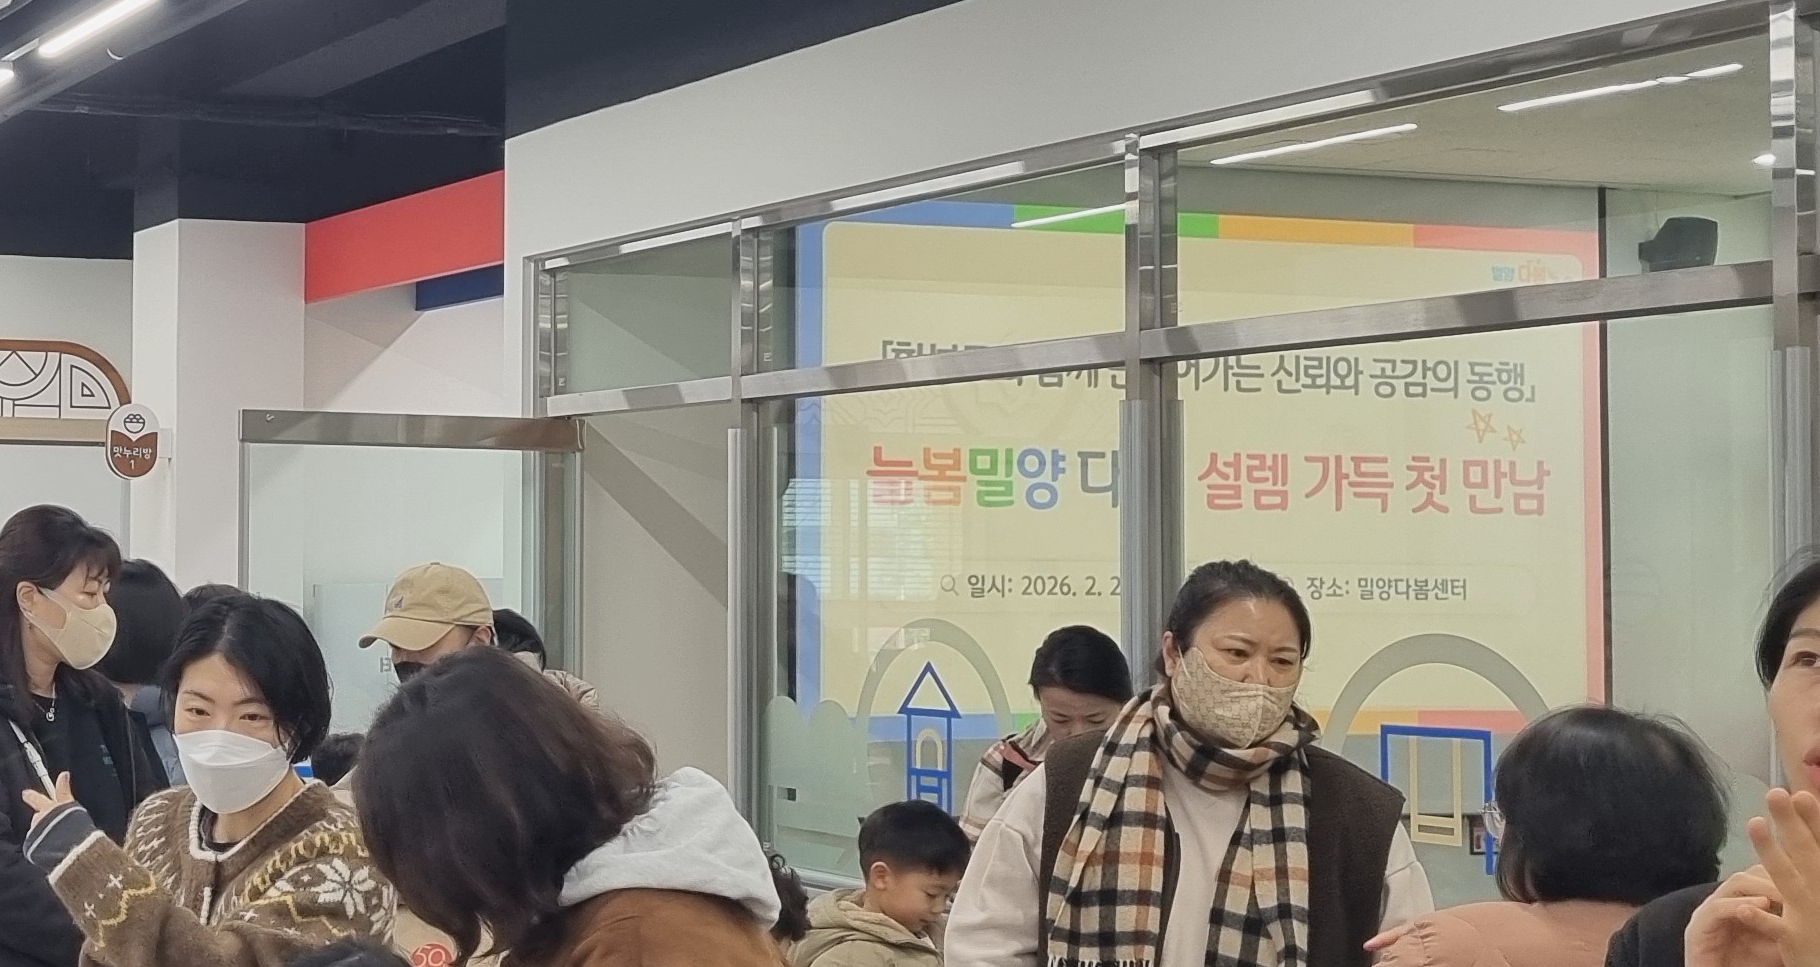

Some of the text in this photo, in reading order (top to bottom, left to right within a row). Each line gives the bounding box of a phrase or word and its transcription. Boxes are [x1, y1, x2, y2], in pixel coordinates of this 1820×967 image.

[1270, 354, 1364, 396] 신뢰와
[1369, 357, 1460, 399] 공감의
[113, 446, 152, 460] 맛누리방
[129, 459, 135, 470] 1
[866, 445, 1120, 510] 늘봄밀양 다
[1197, 452, 1552, 516] 설렘 가득 첫 만남
[967, 574, 1014, 599] 일시:
[1021, 574, 1077, 598] 2026.
[1306, 577, 1468, 602] 장소: 밀양다봄센터
